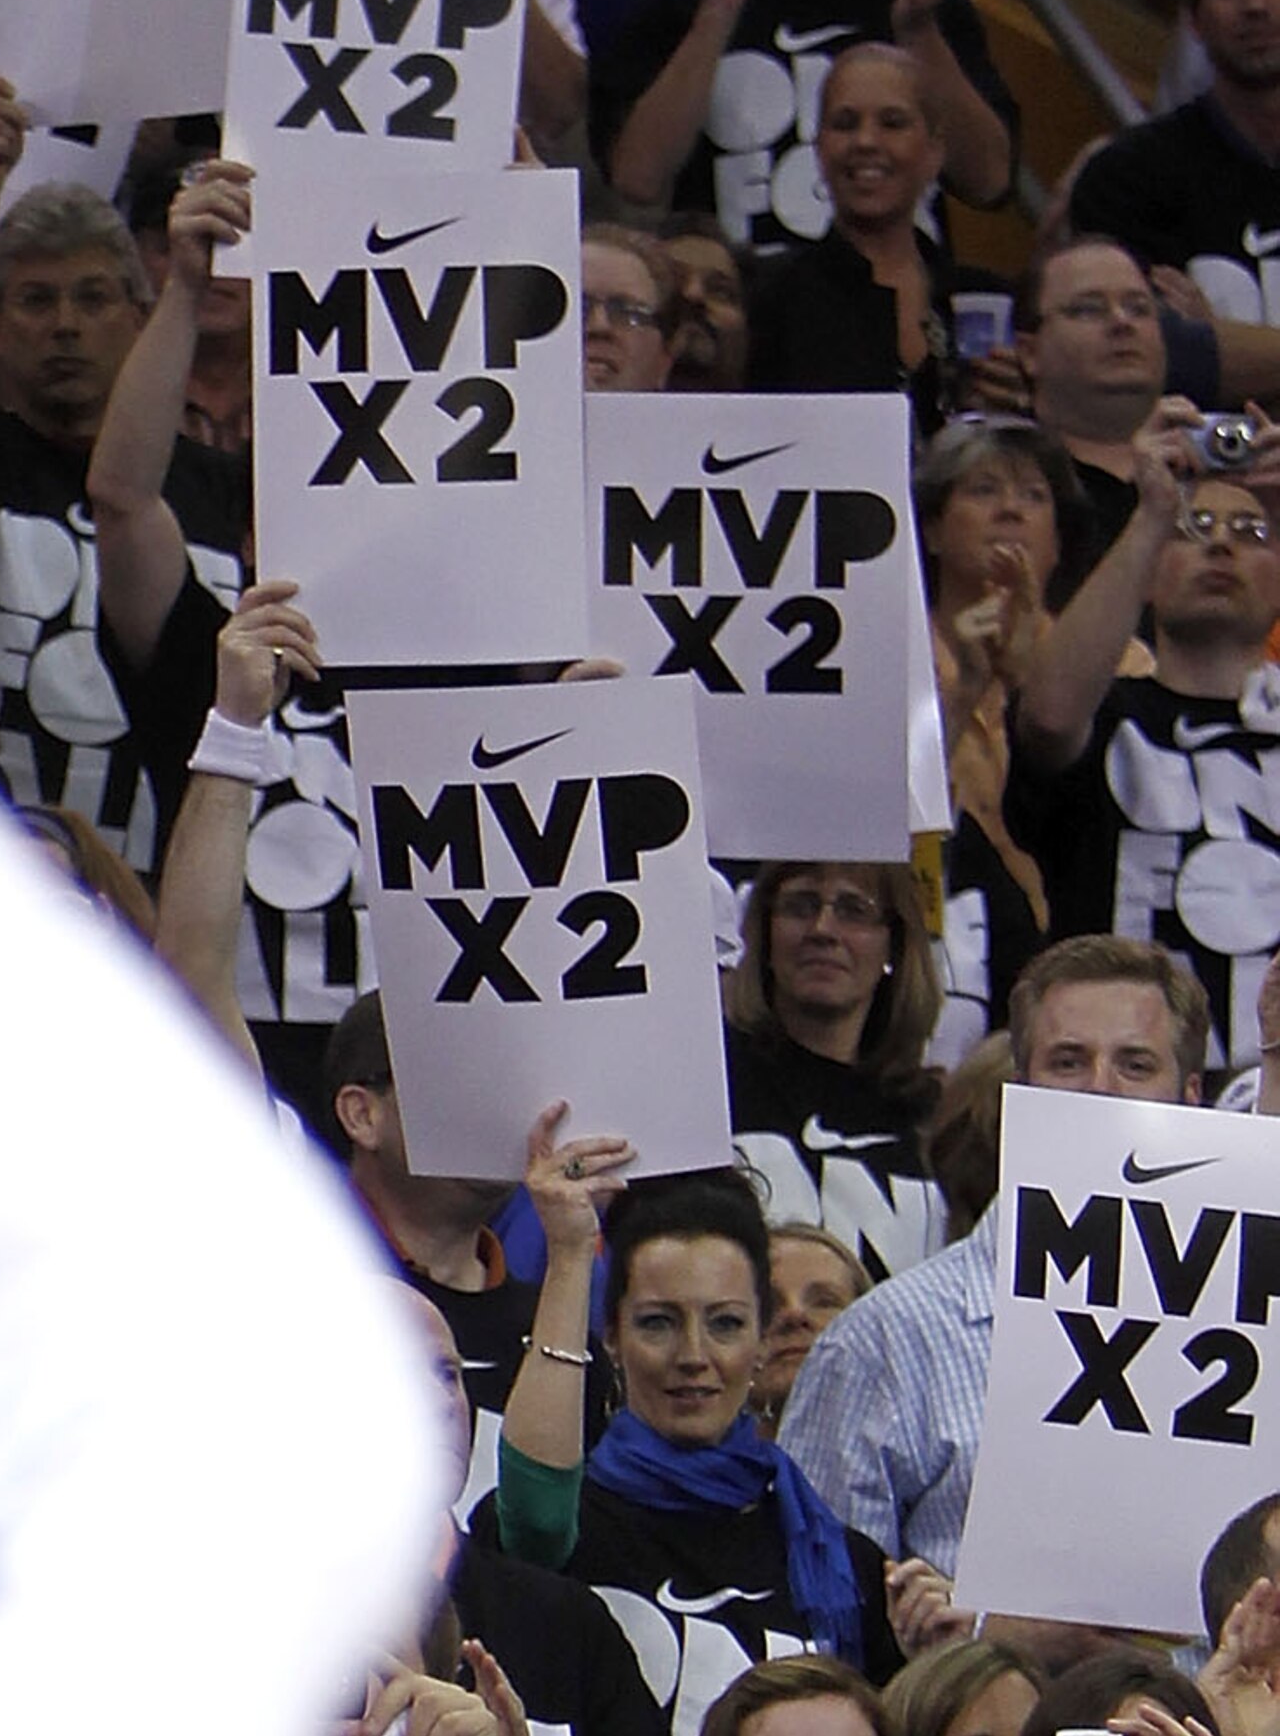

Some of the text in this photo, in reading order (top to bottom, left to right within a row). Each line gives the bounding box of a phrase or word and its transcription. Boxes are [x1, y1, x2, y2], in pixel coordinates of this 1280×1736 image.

[267, 265, 568, 376] MVP
[602, 486, 896, 589] MVP
[371, 772, 690, 890] MVP
